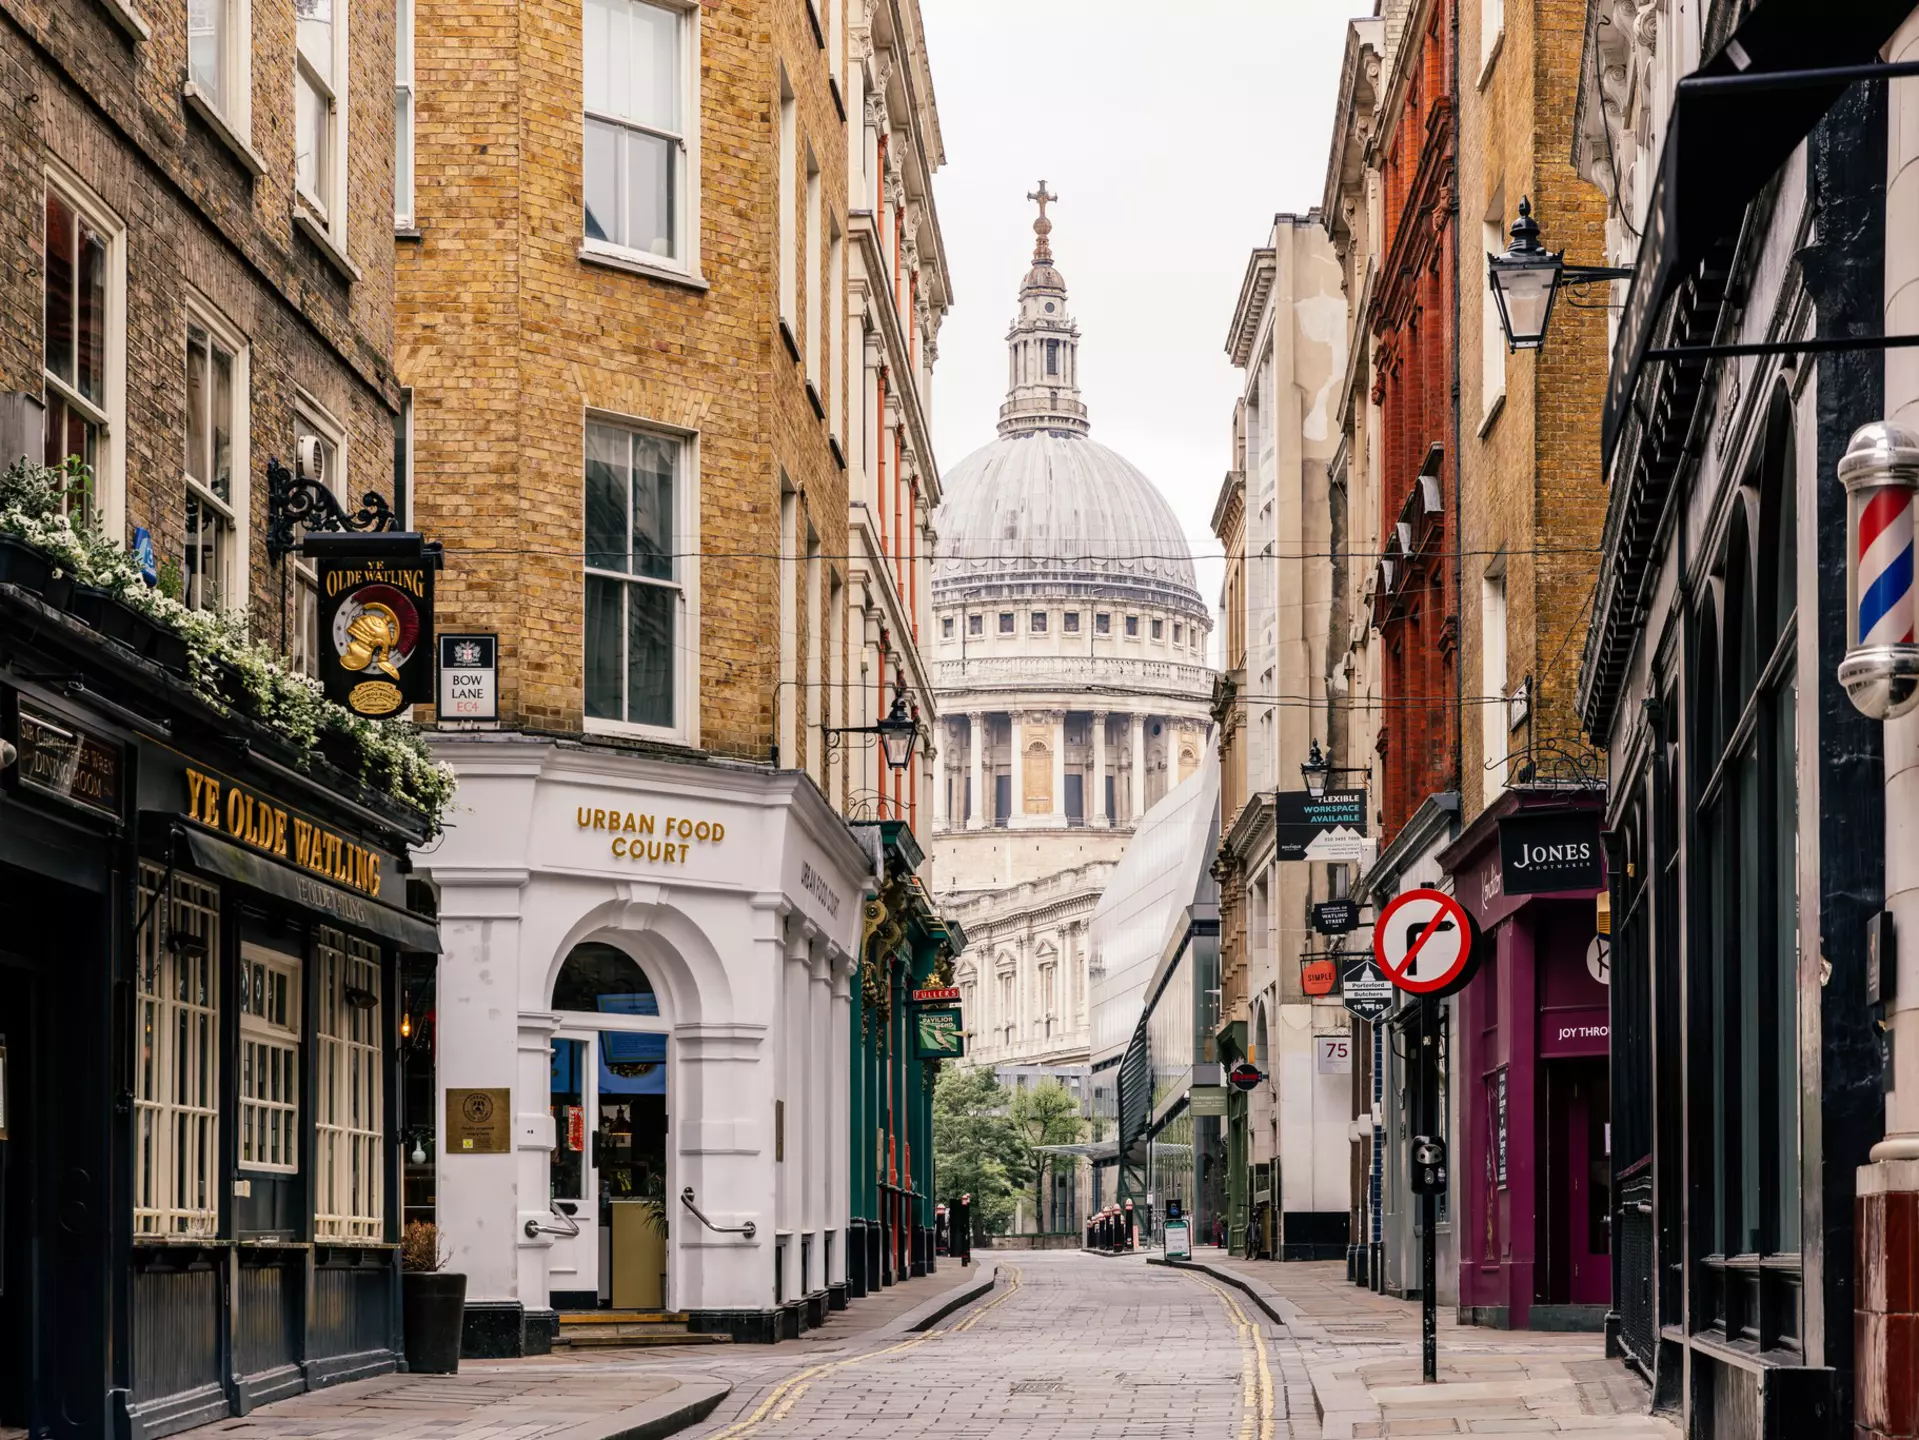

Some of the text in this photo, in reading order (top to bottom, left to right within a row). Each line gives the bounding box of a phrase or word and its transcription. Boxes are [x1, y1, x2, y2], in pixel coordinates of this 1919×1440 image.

[367, 560, 385, 569] YE
[326, 569, 424, 598] OLDE WATLING
[453, 675, 483, 686] BOW
[452, 688, 484, 699] LANE
[456, 701, 479, 713] EC4
[35, 750, 102, 798] DINING ROOM
[1303, 804, 1360, 814] WORKSPACE
[577, 807, 725, 842] URBAN FOOD
[1310, 814, 1360, 823] AVAILABLE
[186, 768, 381, 898] YE OLDE WATLING
[611, 836, 689, 864] COURT
[1513, 843, 1591, 868] JONES
[1528, 861, 1591, 871] BOOTMAKER
[1307, 972, 1333, 982] SIMPLE
[922, 1015, 953, 1025] PAVILION
[1558, 1026, 1611, 1041] JOY THRO
[1325, 1043, 1348, 1058] 75
